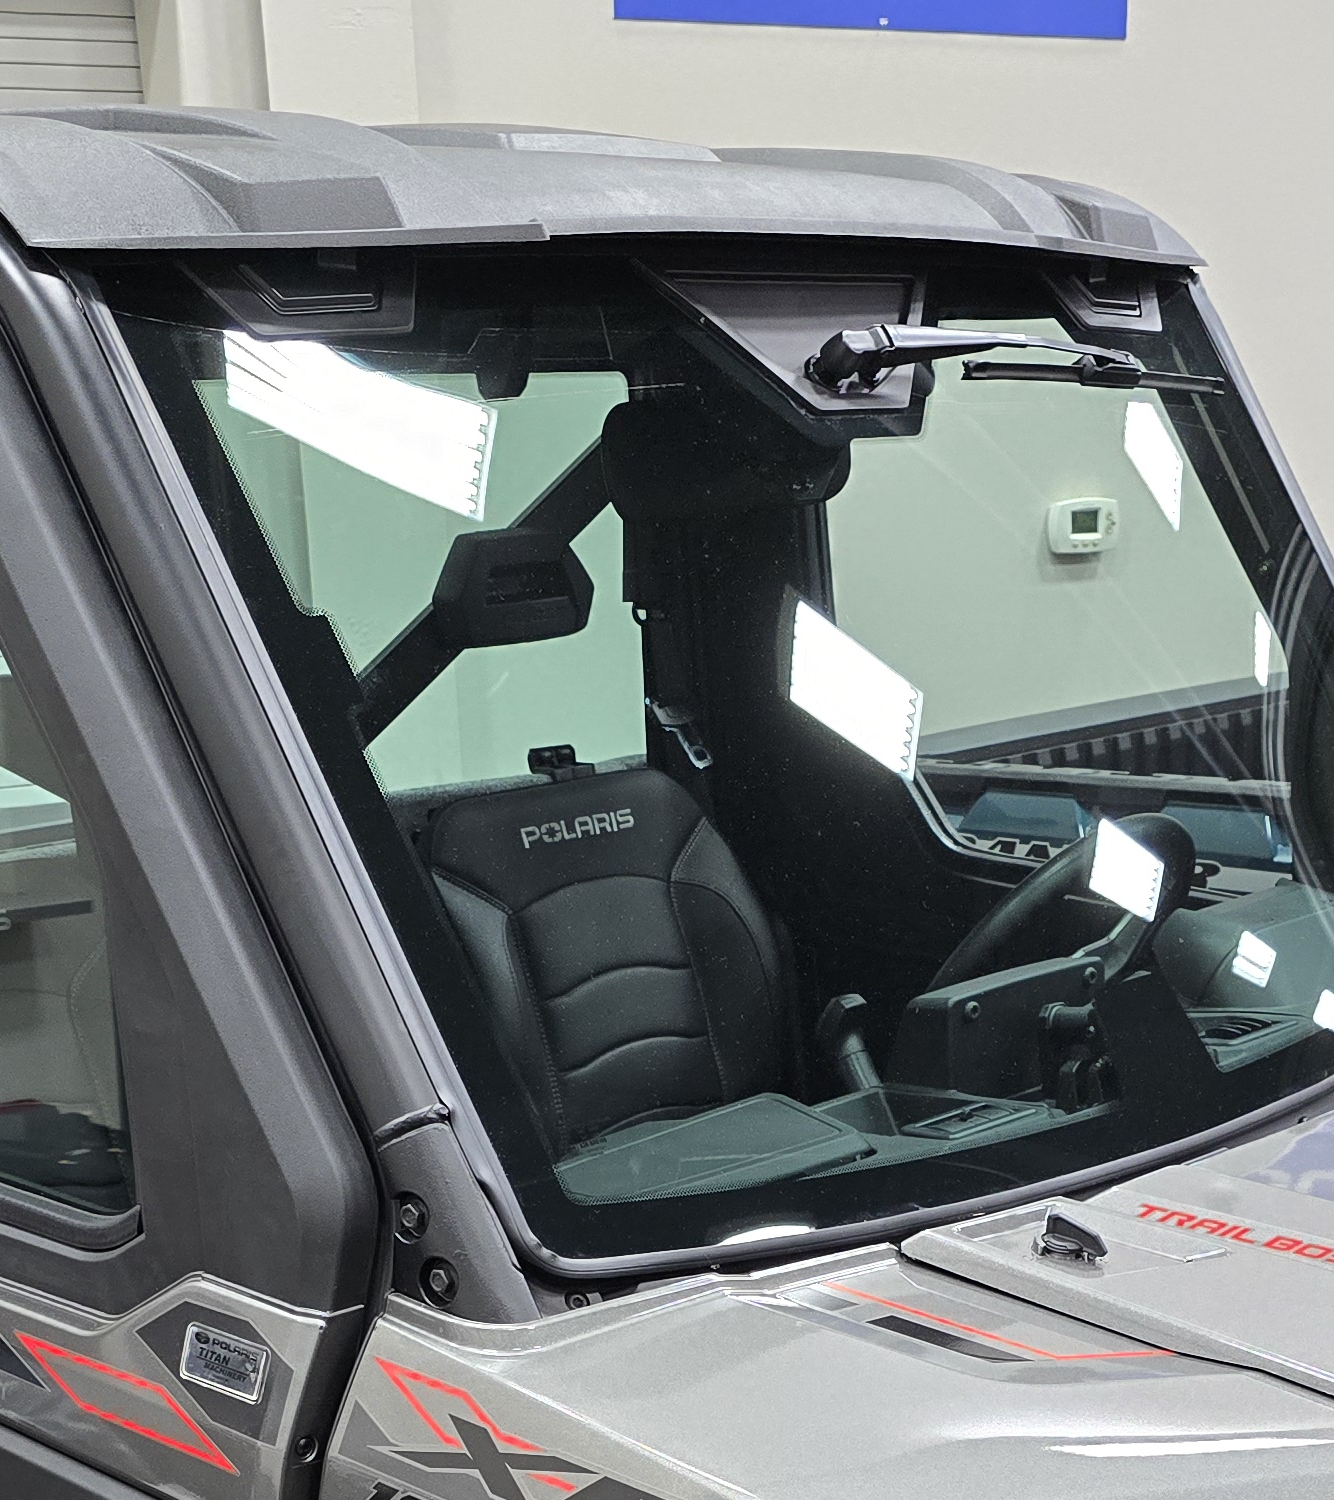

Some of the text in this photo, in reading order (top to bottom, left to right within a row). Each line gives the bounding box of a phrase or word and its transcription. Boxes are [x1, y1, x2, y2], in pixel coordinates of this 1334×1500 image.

[520, 808, 635, 849] POLARIS
[1137, 1203, 1256, 1245] TRAIL
[198, 1346, 231, 1366] TITAN
[211, 1337, 259, 1363] POLARIS
[203, 1362, 248, 1383] MACHINERY
